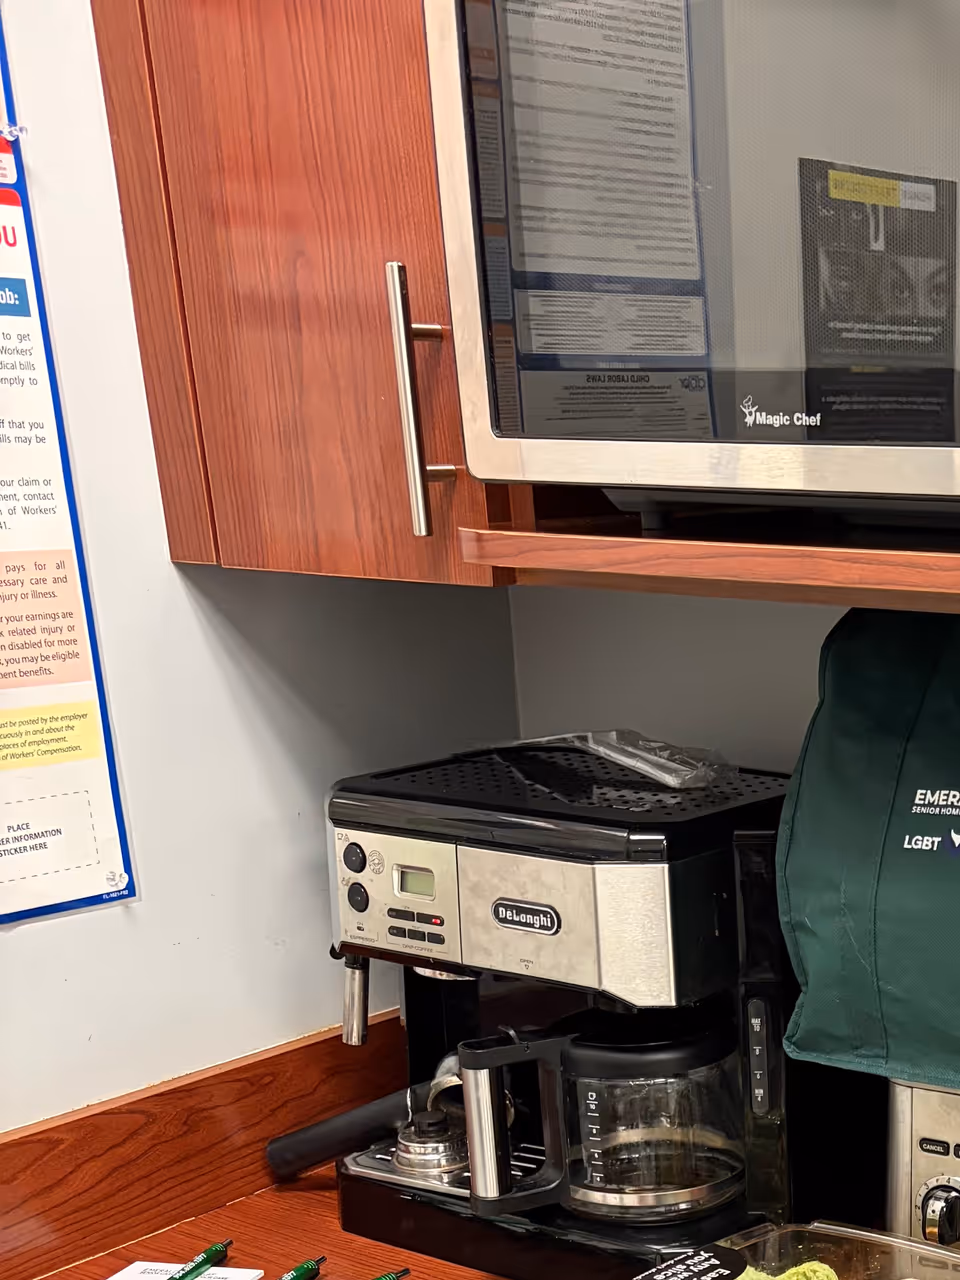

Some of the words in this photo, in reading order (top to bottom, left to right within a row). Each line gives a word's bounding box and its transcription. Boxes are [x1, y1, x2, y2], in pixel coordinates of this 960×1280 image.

[17, 333, 31, 343] get
[19, 361, 36, 371] bills
[756, 411, 790, 427] Magic
[793, 412, 821, 426] Chef
[8, 420, 25, 429] that
[28, 422, 44, 431] you
[14, 436, 32, 445] may
[35, 435, 46, 443] be
[18, 477, 40, 487] claim
[23, 492, 55, 500] contact
[8, 506, 17, 515] of
[21, 506, 57, 515] Workers'
[5, 563, 26, 574] pays
[34, 561, 47, 571] for
[55, 560, 66, 570] all
[29, 577, 48, 585] care
[52, 574, 68, 584] and
[31, 590, 58, 599] illness.
[5, 614, 24, 625] your
[25, 611, 60, 623] earnings
[61, 610, 74, 619] are
[8, 626, 37, 637] related
[40, 624, 63, 636] injury
[8, 639, 42, 651] disabled
[44, 639, 56, 648] for
[57, 637, 78, 646] more
[21, 655, 41, 665] may
[40, 653, 51, 662] be
[51, 650, 80, 662] eligible
[18, 666, 54, 677] benefits.
[18, 718, 40, 727] posted
[60, 712, 88, 723] employer
[46, 725, 64, 734] about
[911, 805, 940, 815] SENIOR
[7, 822, 31, 833] PLACE
[11, 828, 62, 843] INFORMATION
[29, 842, 48, 852] HERE
[903, 834, 942, 851] LGBT
[922, 1143, 945, 1153] CANCEL
[685, 1251, 714, 1266] you
[690, 1258, 721, 1273] Any
[653, 1264, 687, 1280] slice
